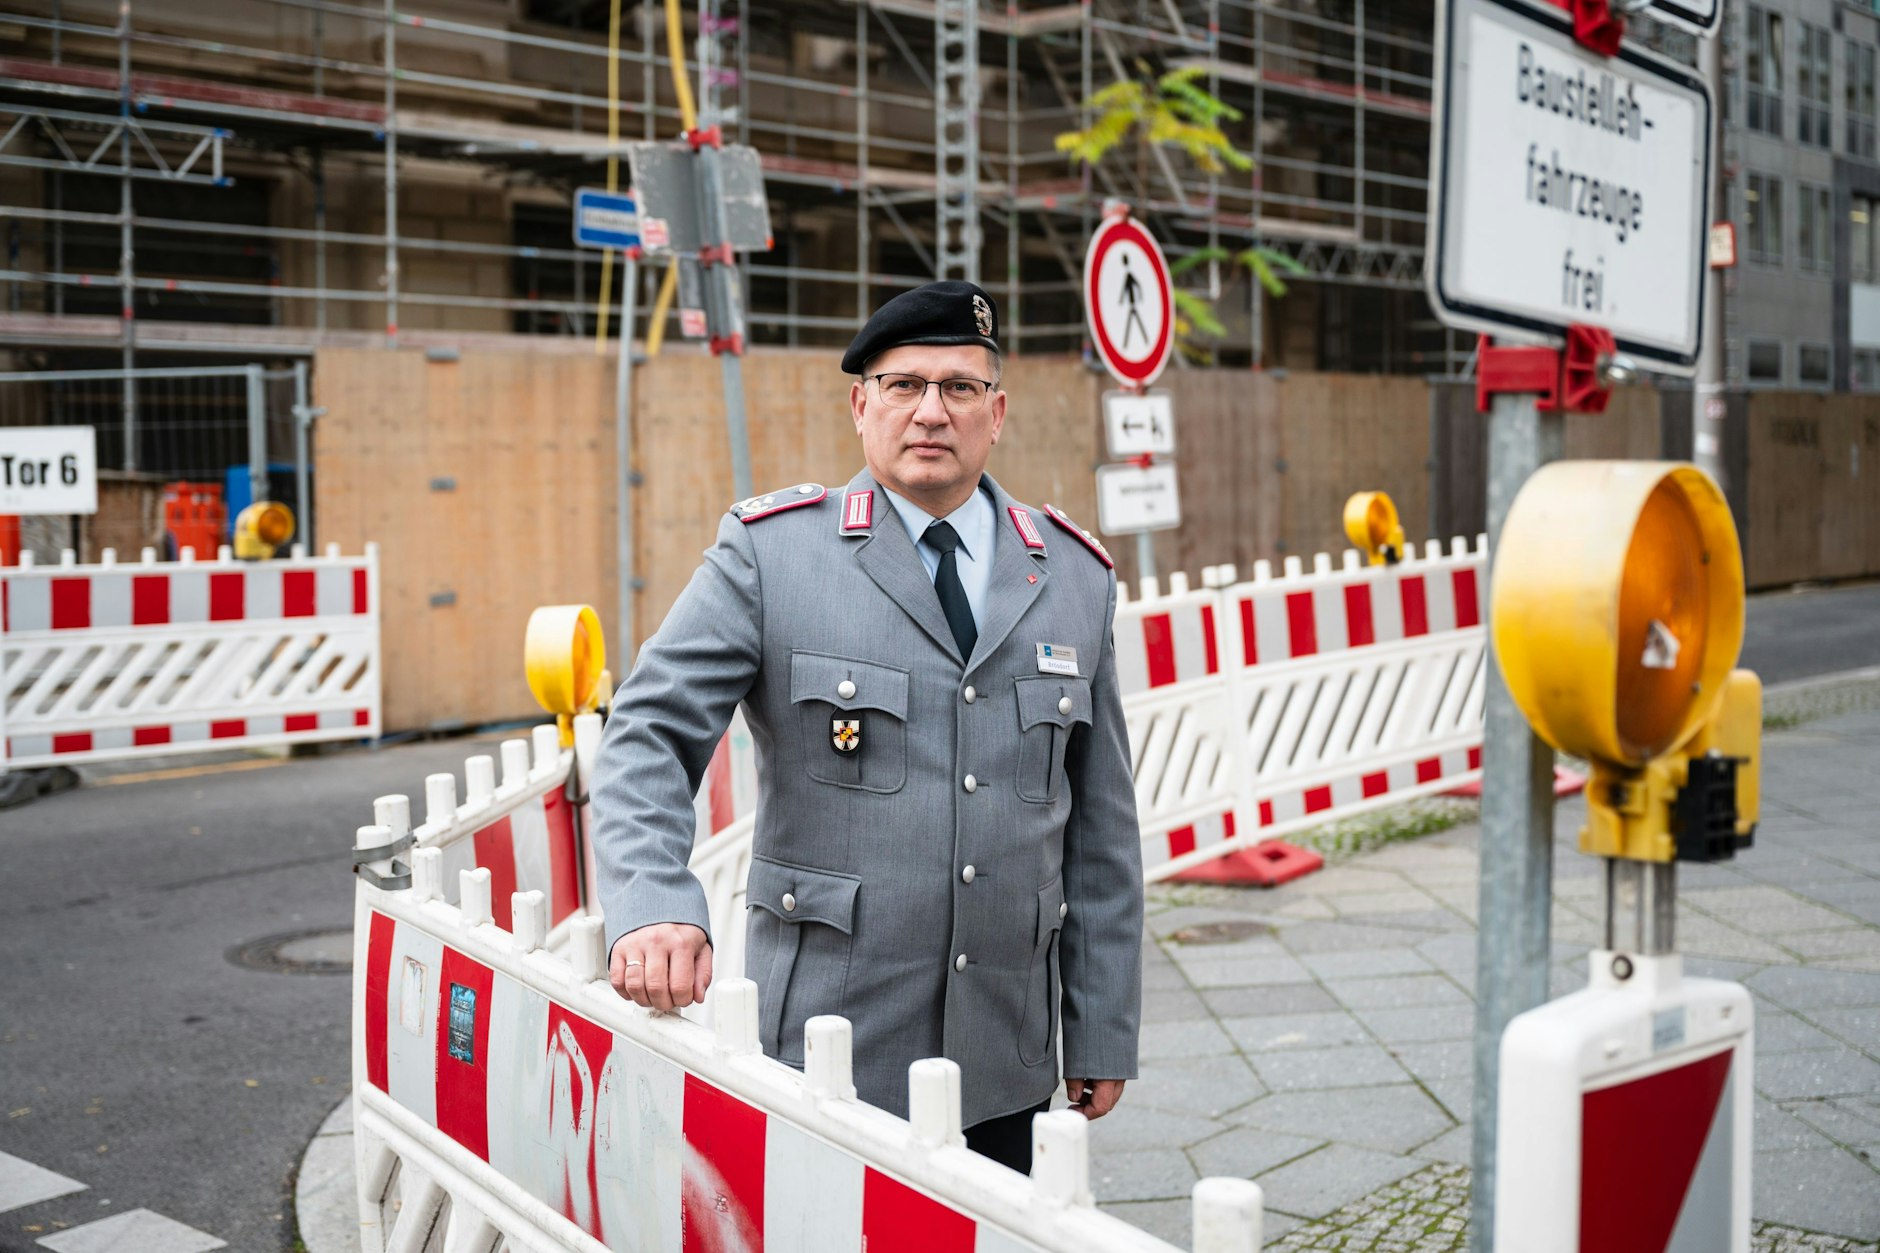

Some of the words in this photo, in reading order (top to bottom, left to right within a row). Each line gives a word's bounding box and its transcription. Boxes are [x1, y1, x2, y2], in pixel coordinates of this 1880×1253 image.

[1517, 43, 1654, 142] Baustellen-
[1526, 143, 1643, 244] fahrzeuge
[1562, 249, 1604, 312] frei
[1, 456, 50, 485] Tor
[61, 455, 78, 486] 6
